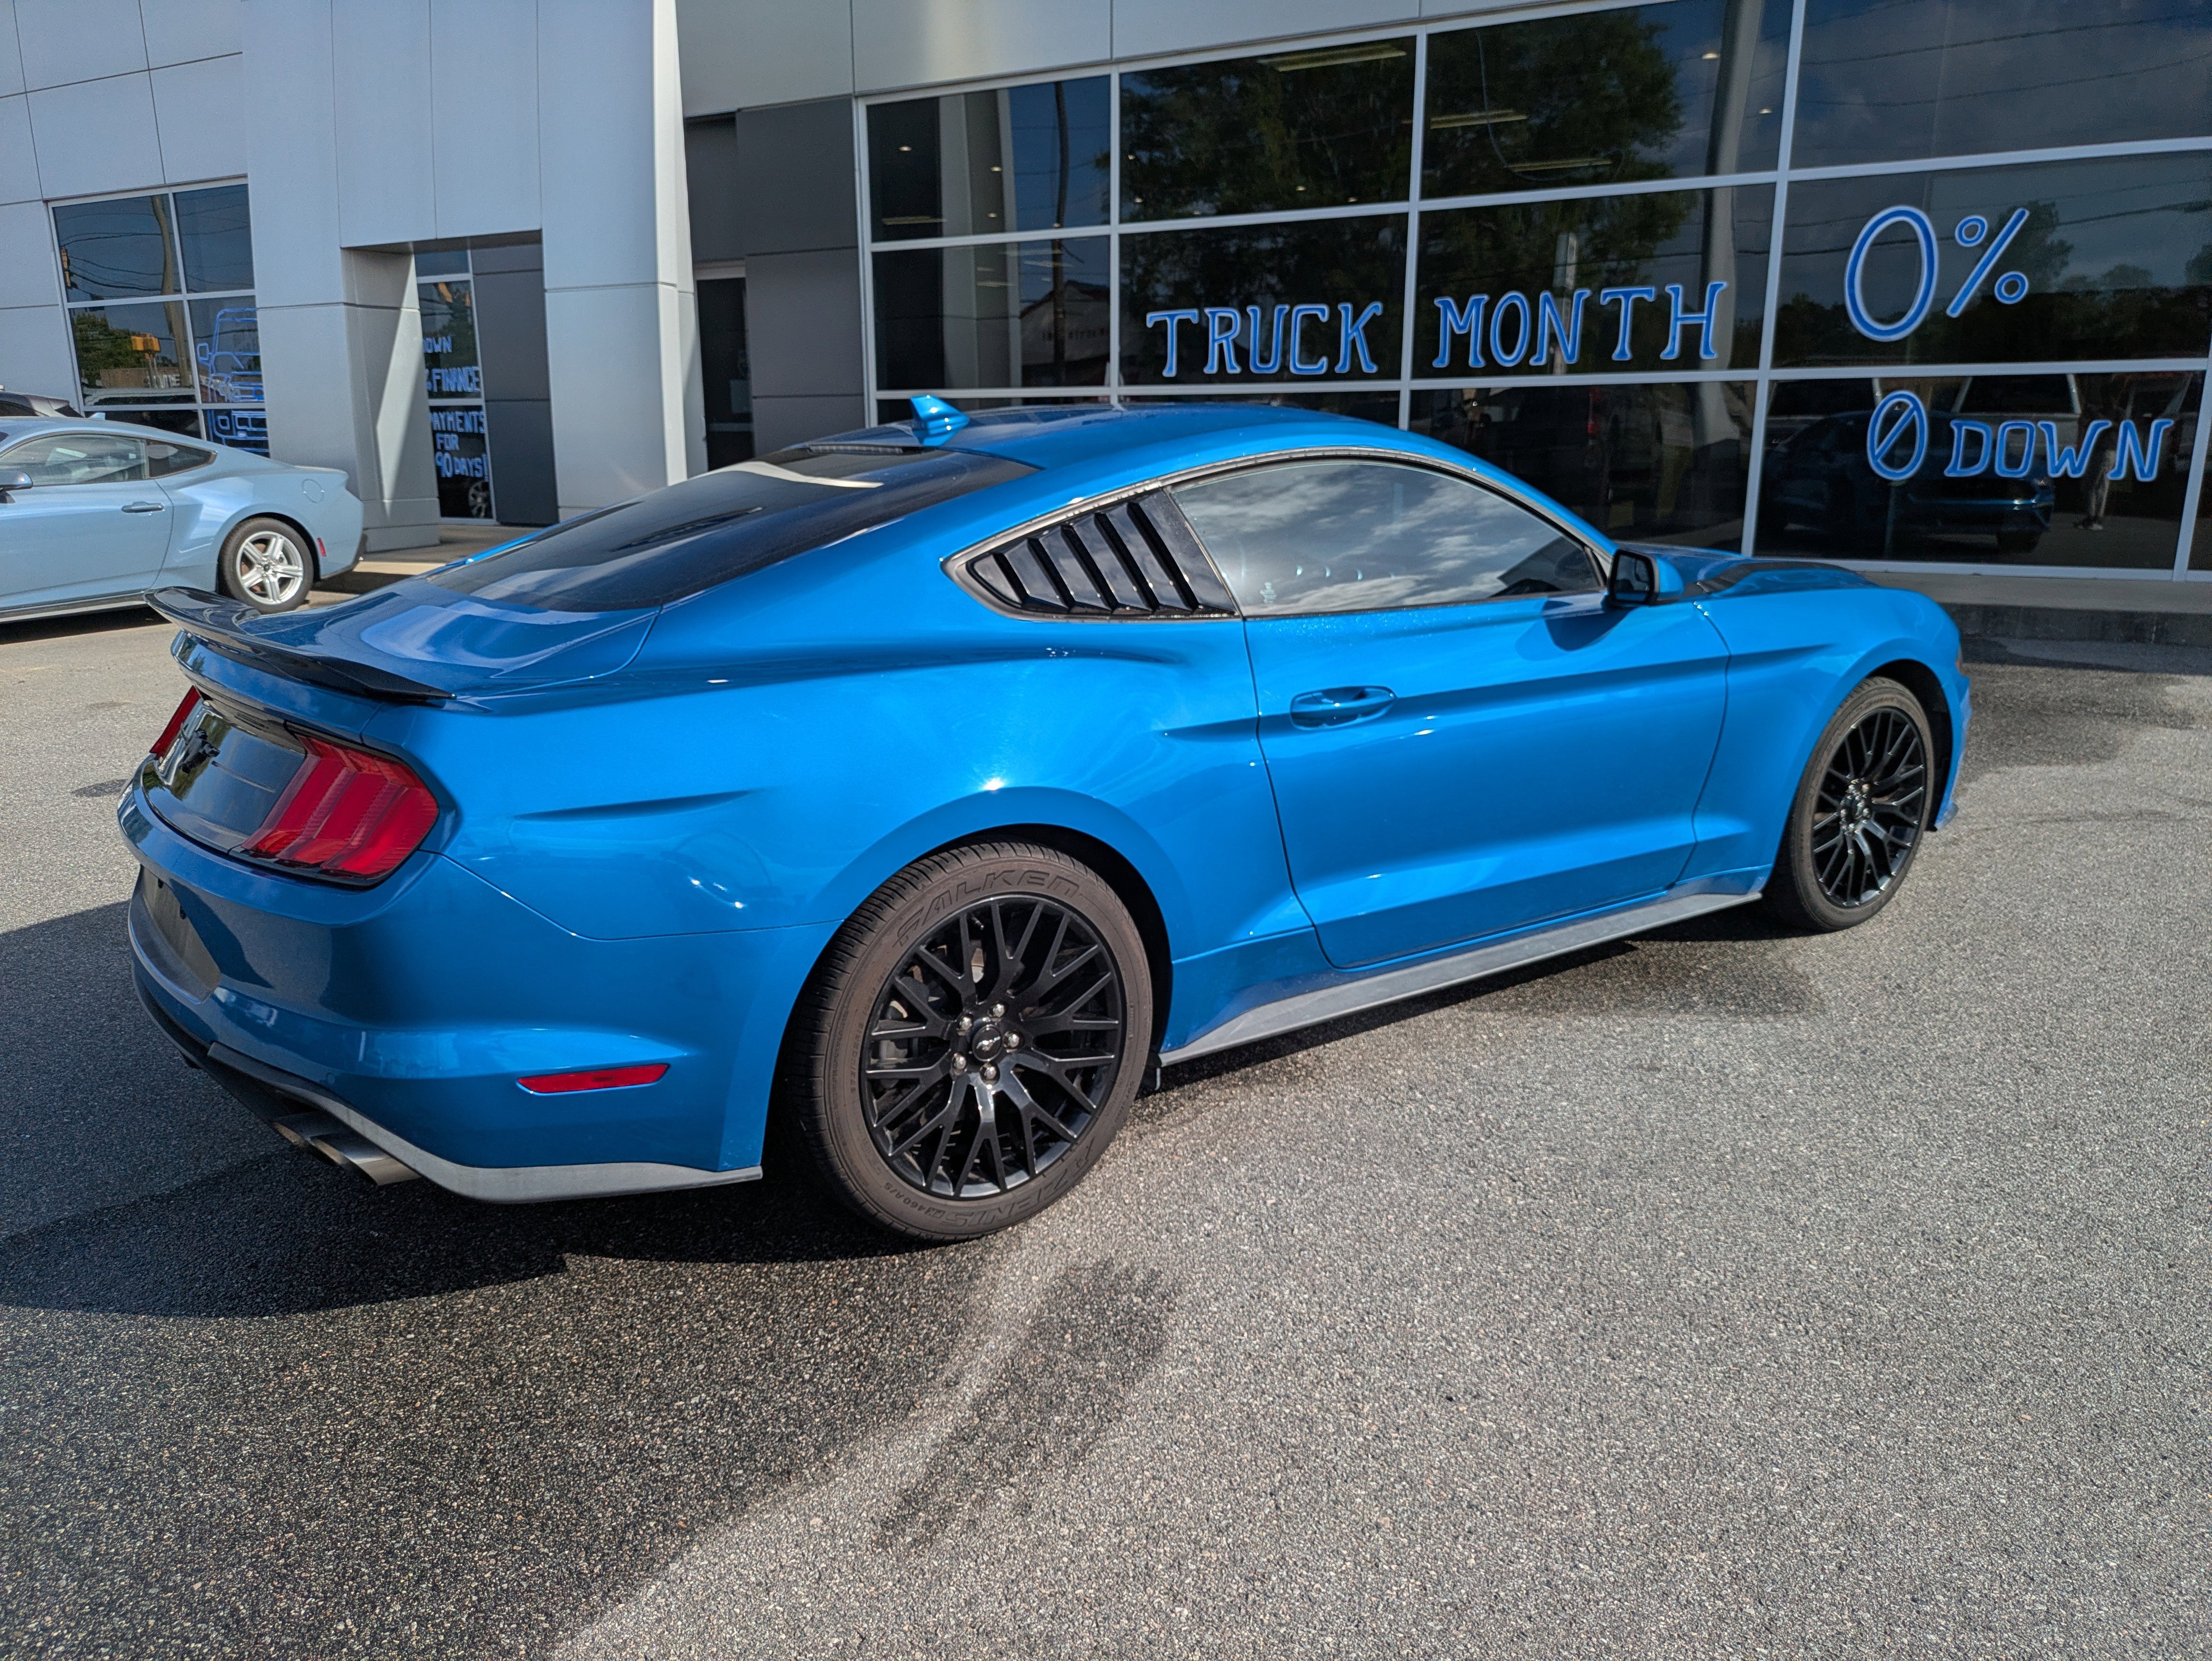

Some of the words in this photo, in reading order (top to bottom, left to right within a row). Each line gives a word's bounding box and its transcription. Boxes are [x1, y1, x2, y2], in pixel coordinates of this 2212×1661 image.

[1845, 205, 2029, 342] 0%
[1146, 301, 1383, 378] TRUCK
[1432, 281, 1727, 368] MONTH
[435, 451, 453, 477] 90
[436, 433, 459, 450] FOR
[1944, 419, 2174, 481] DOWN
[892, 870, 1079, 948] FALKEN
